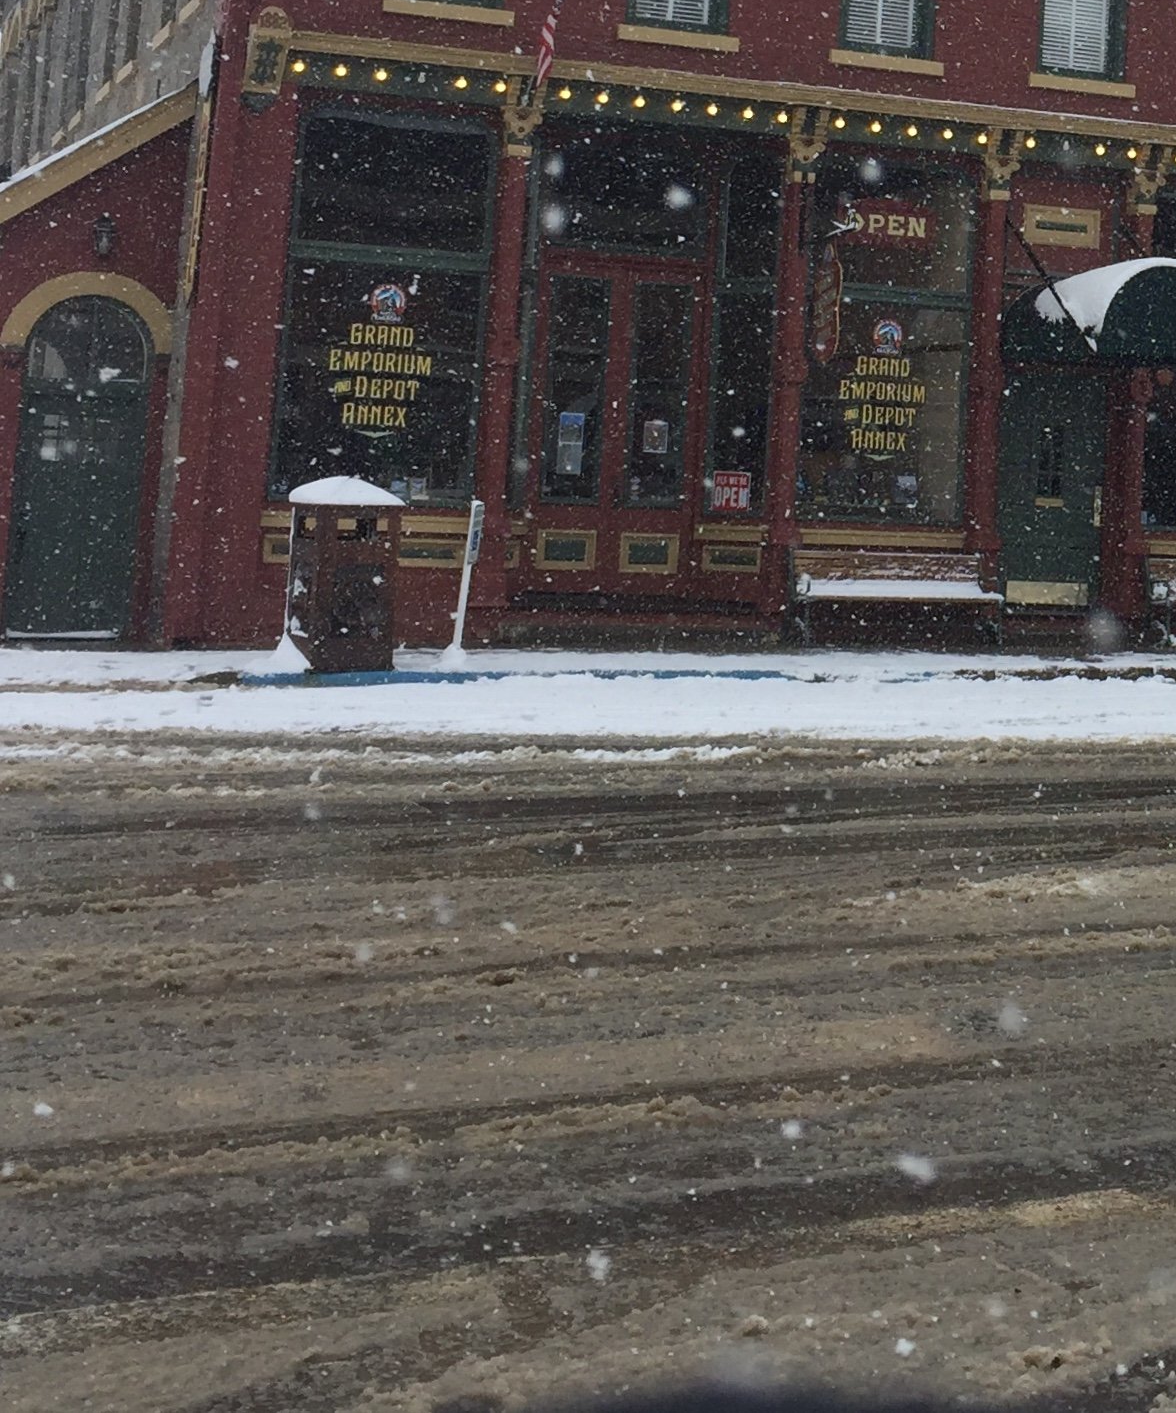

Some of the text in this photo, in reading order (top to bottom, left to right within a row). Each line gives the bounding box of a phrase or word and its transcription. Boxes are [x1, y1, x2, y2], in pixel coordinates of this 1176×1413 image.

[350, 323, 414, 347] GRAND
[329, 349, 432, 376] EMPORIUM
[856, 356, 910, 377] GRAND
[355, 376, 420, 401] DEPOT
[839, 379, 926, 404] EMPORIUM
[342, 402, 407, 428] ANNEX
[862, 404, 916, 427] DEPOT
[851, 428, 907, 452] ANNEX
[714, 486, 748, 508] OPEN
